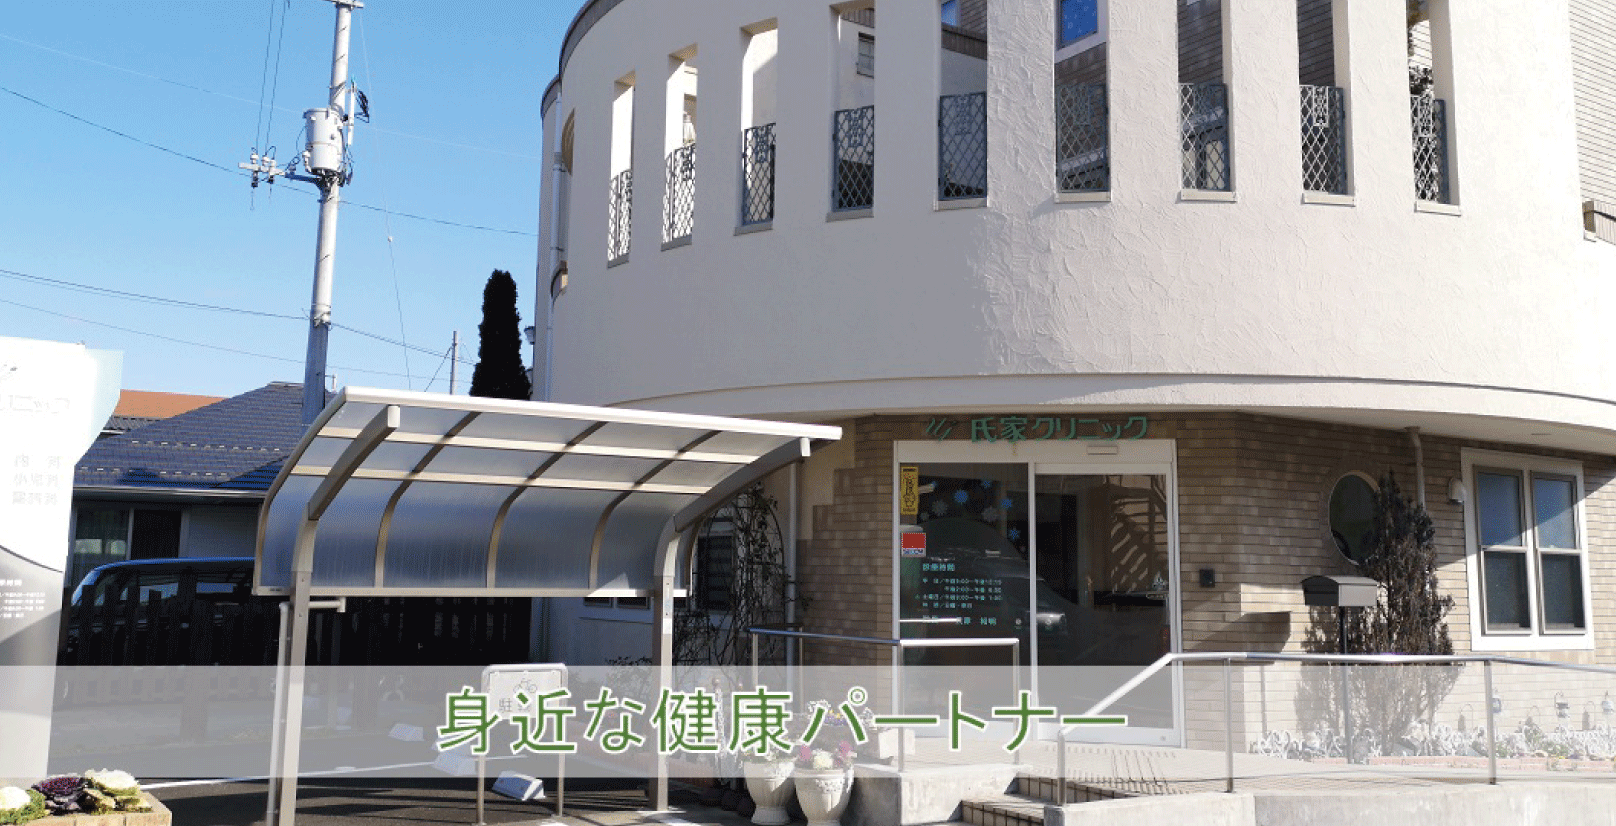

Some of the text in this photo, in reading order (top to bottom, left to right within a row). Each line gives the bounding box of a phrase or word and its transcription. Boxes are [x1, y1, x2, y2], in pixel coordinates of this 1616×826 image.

[971, 416, 1147, 442] 氏家クリニック
